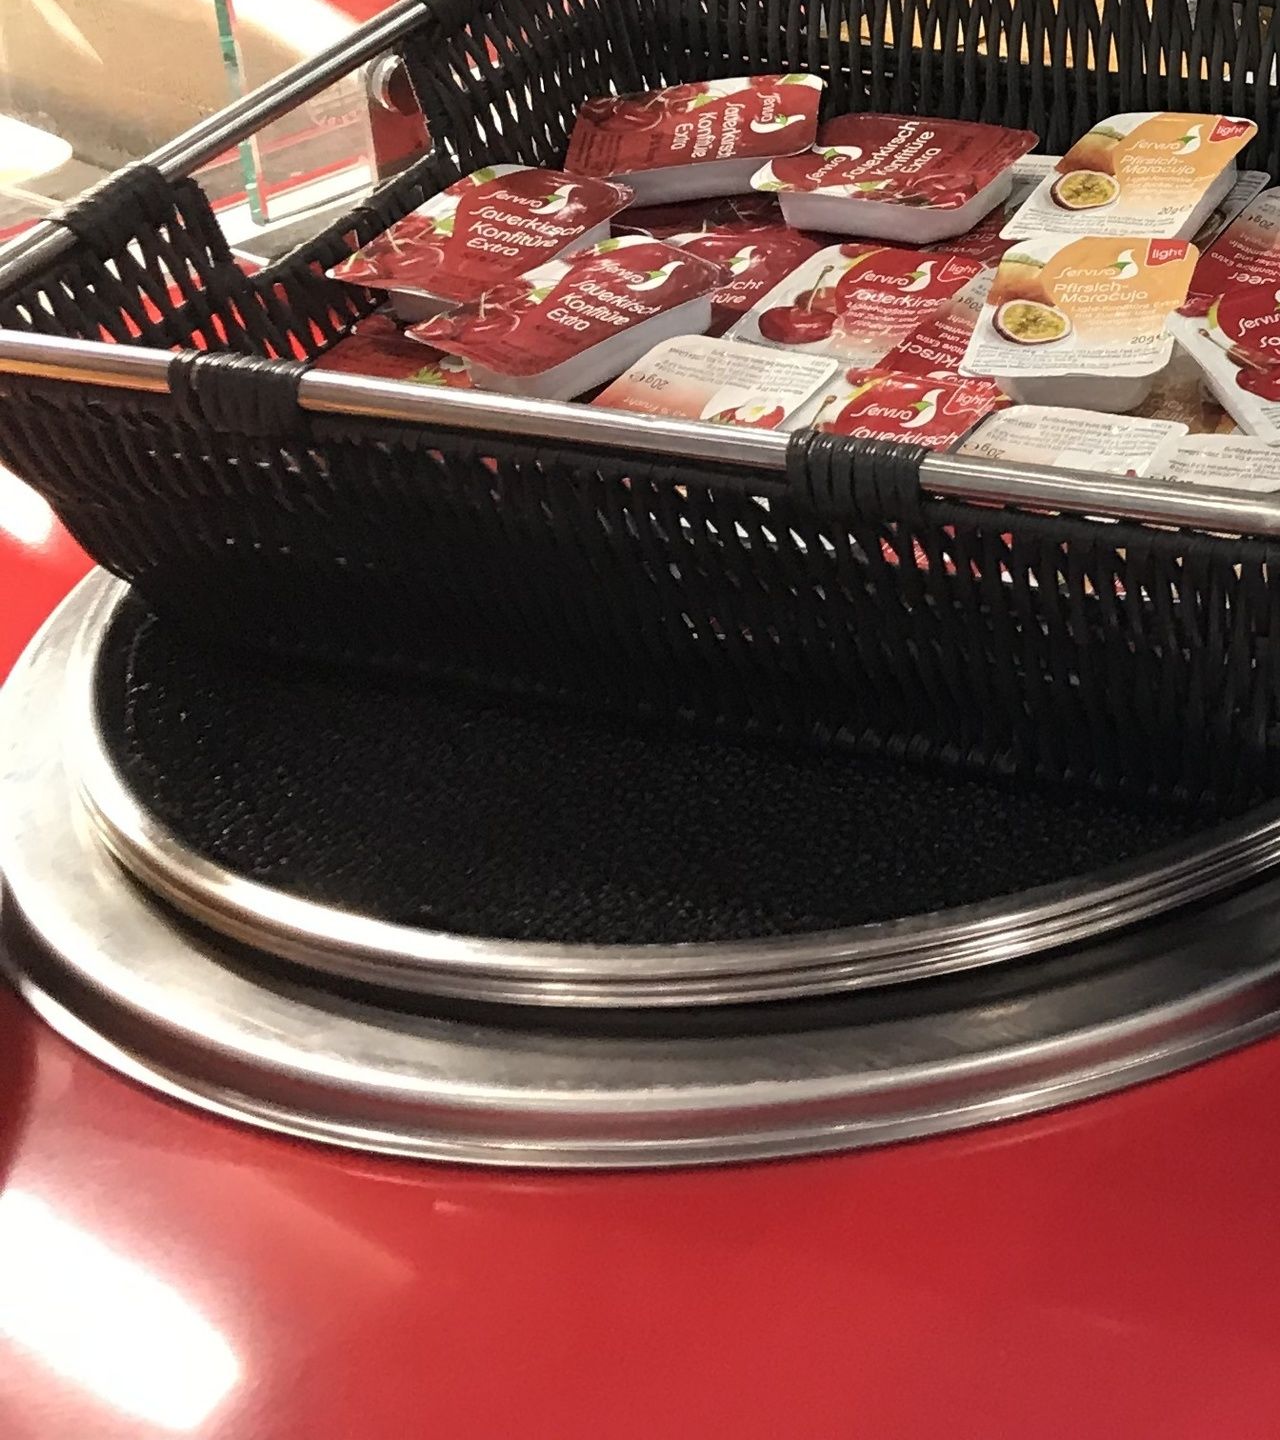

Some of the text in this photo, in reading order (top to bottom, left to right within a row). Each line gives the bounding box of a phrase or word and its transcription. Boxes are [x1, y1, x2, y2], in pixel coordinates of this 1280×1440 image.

[670, 122, 694, 151] Extra
[1215, 124, 1246, 137] light
[842, 121, 920, 180] Sauerkirsch
[870, 131, 935, 176] Konfitüre
[900, 147, 942, 174] Extra
[1121, 154, 1186, 166] Pfirsich-
[1121, 164, 1196, 175] Maracuja
[469, 205, 586, 237] Sauerkirsch
[468, 221, 559, 248] Konfitüre
[466, 237, 520, 257] Extra
[1151, 246, 1185, 260] light
[1211, 251, 1235, 267] Extra
[1233, 253, 1255, 263] und
[947, 263, 978, 275] light
[1053, 280, 1129, 293] Pfirsich-
[844, 289, 947, 308] Sauerkirsc
[1060, 290, 1149, 304] Maracuja
[557, 292, 631, 326] Konfitüre
[546, 307, 592, 332] Extra
[915, 333, 941, 345] Extra
[940, 332, 962, 343] und
[1130, 334, 1155, 345] 20g
[896, 340, 960, 369] rkirsch
[954, 391, 988, 407] light
[849, 425, 960, 447] Sauerkirsch
